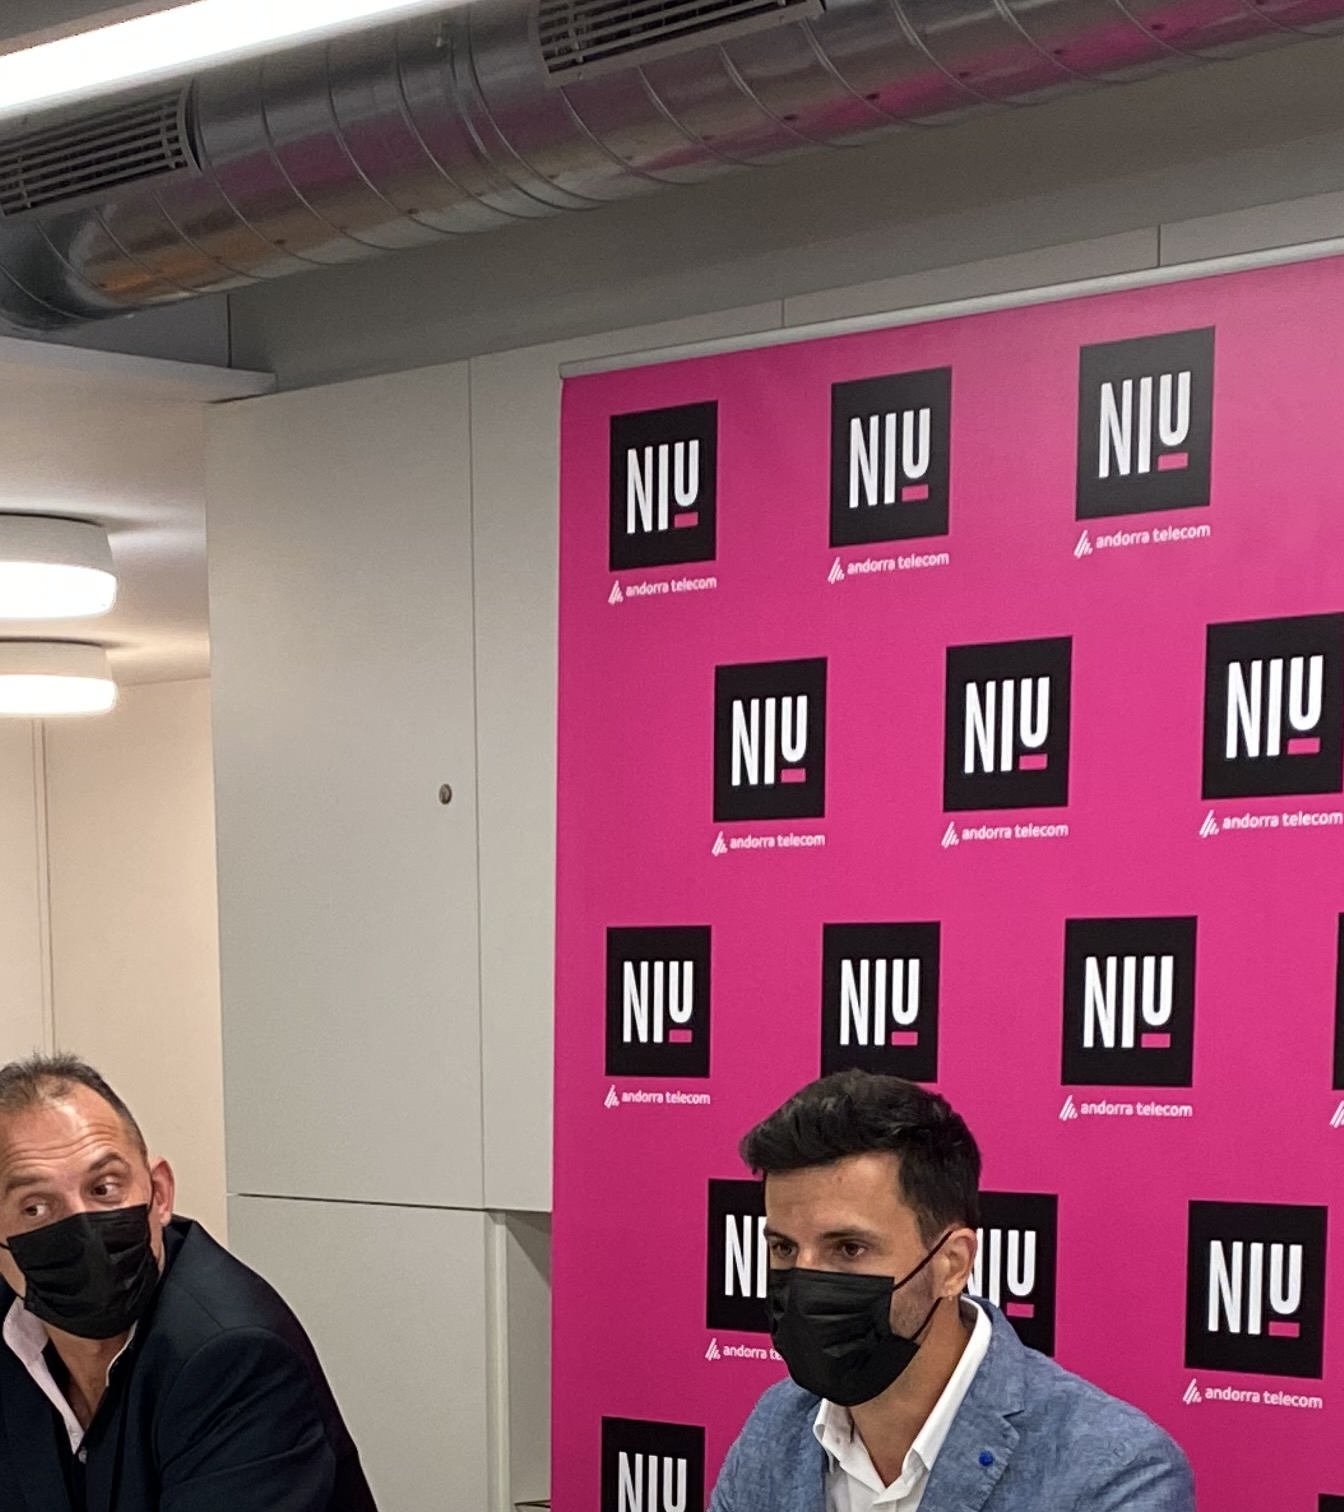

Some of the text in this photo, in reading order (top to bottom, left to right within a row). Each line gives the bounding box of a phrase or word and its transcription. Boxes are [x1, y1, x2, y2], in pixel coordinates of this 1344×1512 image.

[850, 408, 930, 508] NIU
[1099, 371, 1190, 478] NIU
[627, 440, 699, 533] NIU
[847, 552, 950, 575] andorra telecom
[1095, 524, 1211, 549] andorra telecom
[625, 577, 718, 597] andorra telecom
[732, 696, 807, 786] NIU
[965, 677, 1049, 773] NIU
[1226, 656, 1323, 758] NIU
[728, 833, 826, 851] andorra telecom
[961, 823, 1069, 841] andorra telecom
[1222, 810, 1344, 830] andorra telecom
[623, 961, 693, 1043] NIU
[840, 959, 919, 1045] NIU
[1084, 956, 1173, 1048] NIU
[621, 1089, 711, 1105] andorra telecom
[1080, 1100, 1193, 1117] andorra telecom
[724, 1214, 767, 1298] NI
[1208, 1241, 1302, 1335] NIU
[722, 1344, 768, 1360] andorra
[1204, 1386, 1323, 1409] andorra telecom
